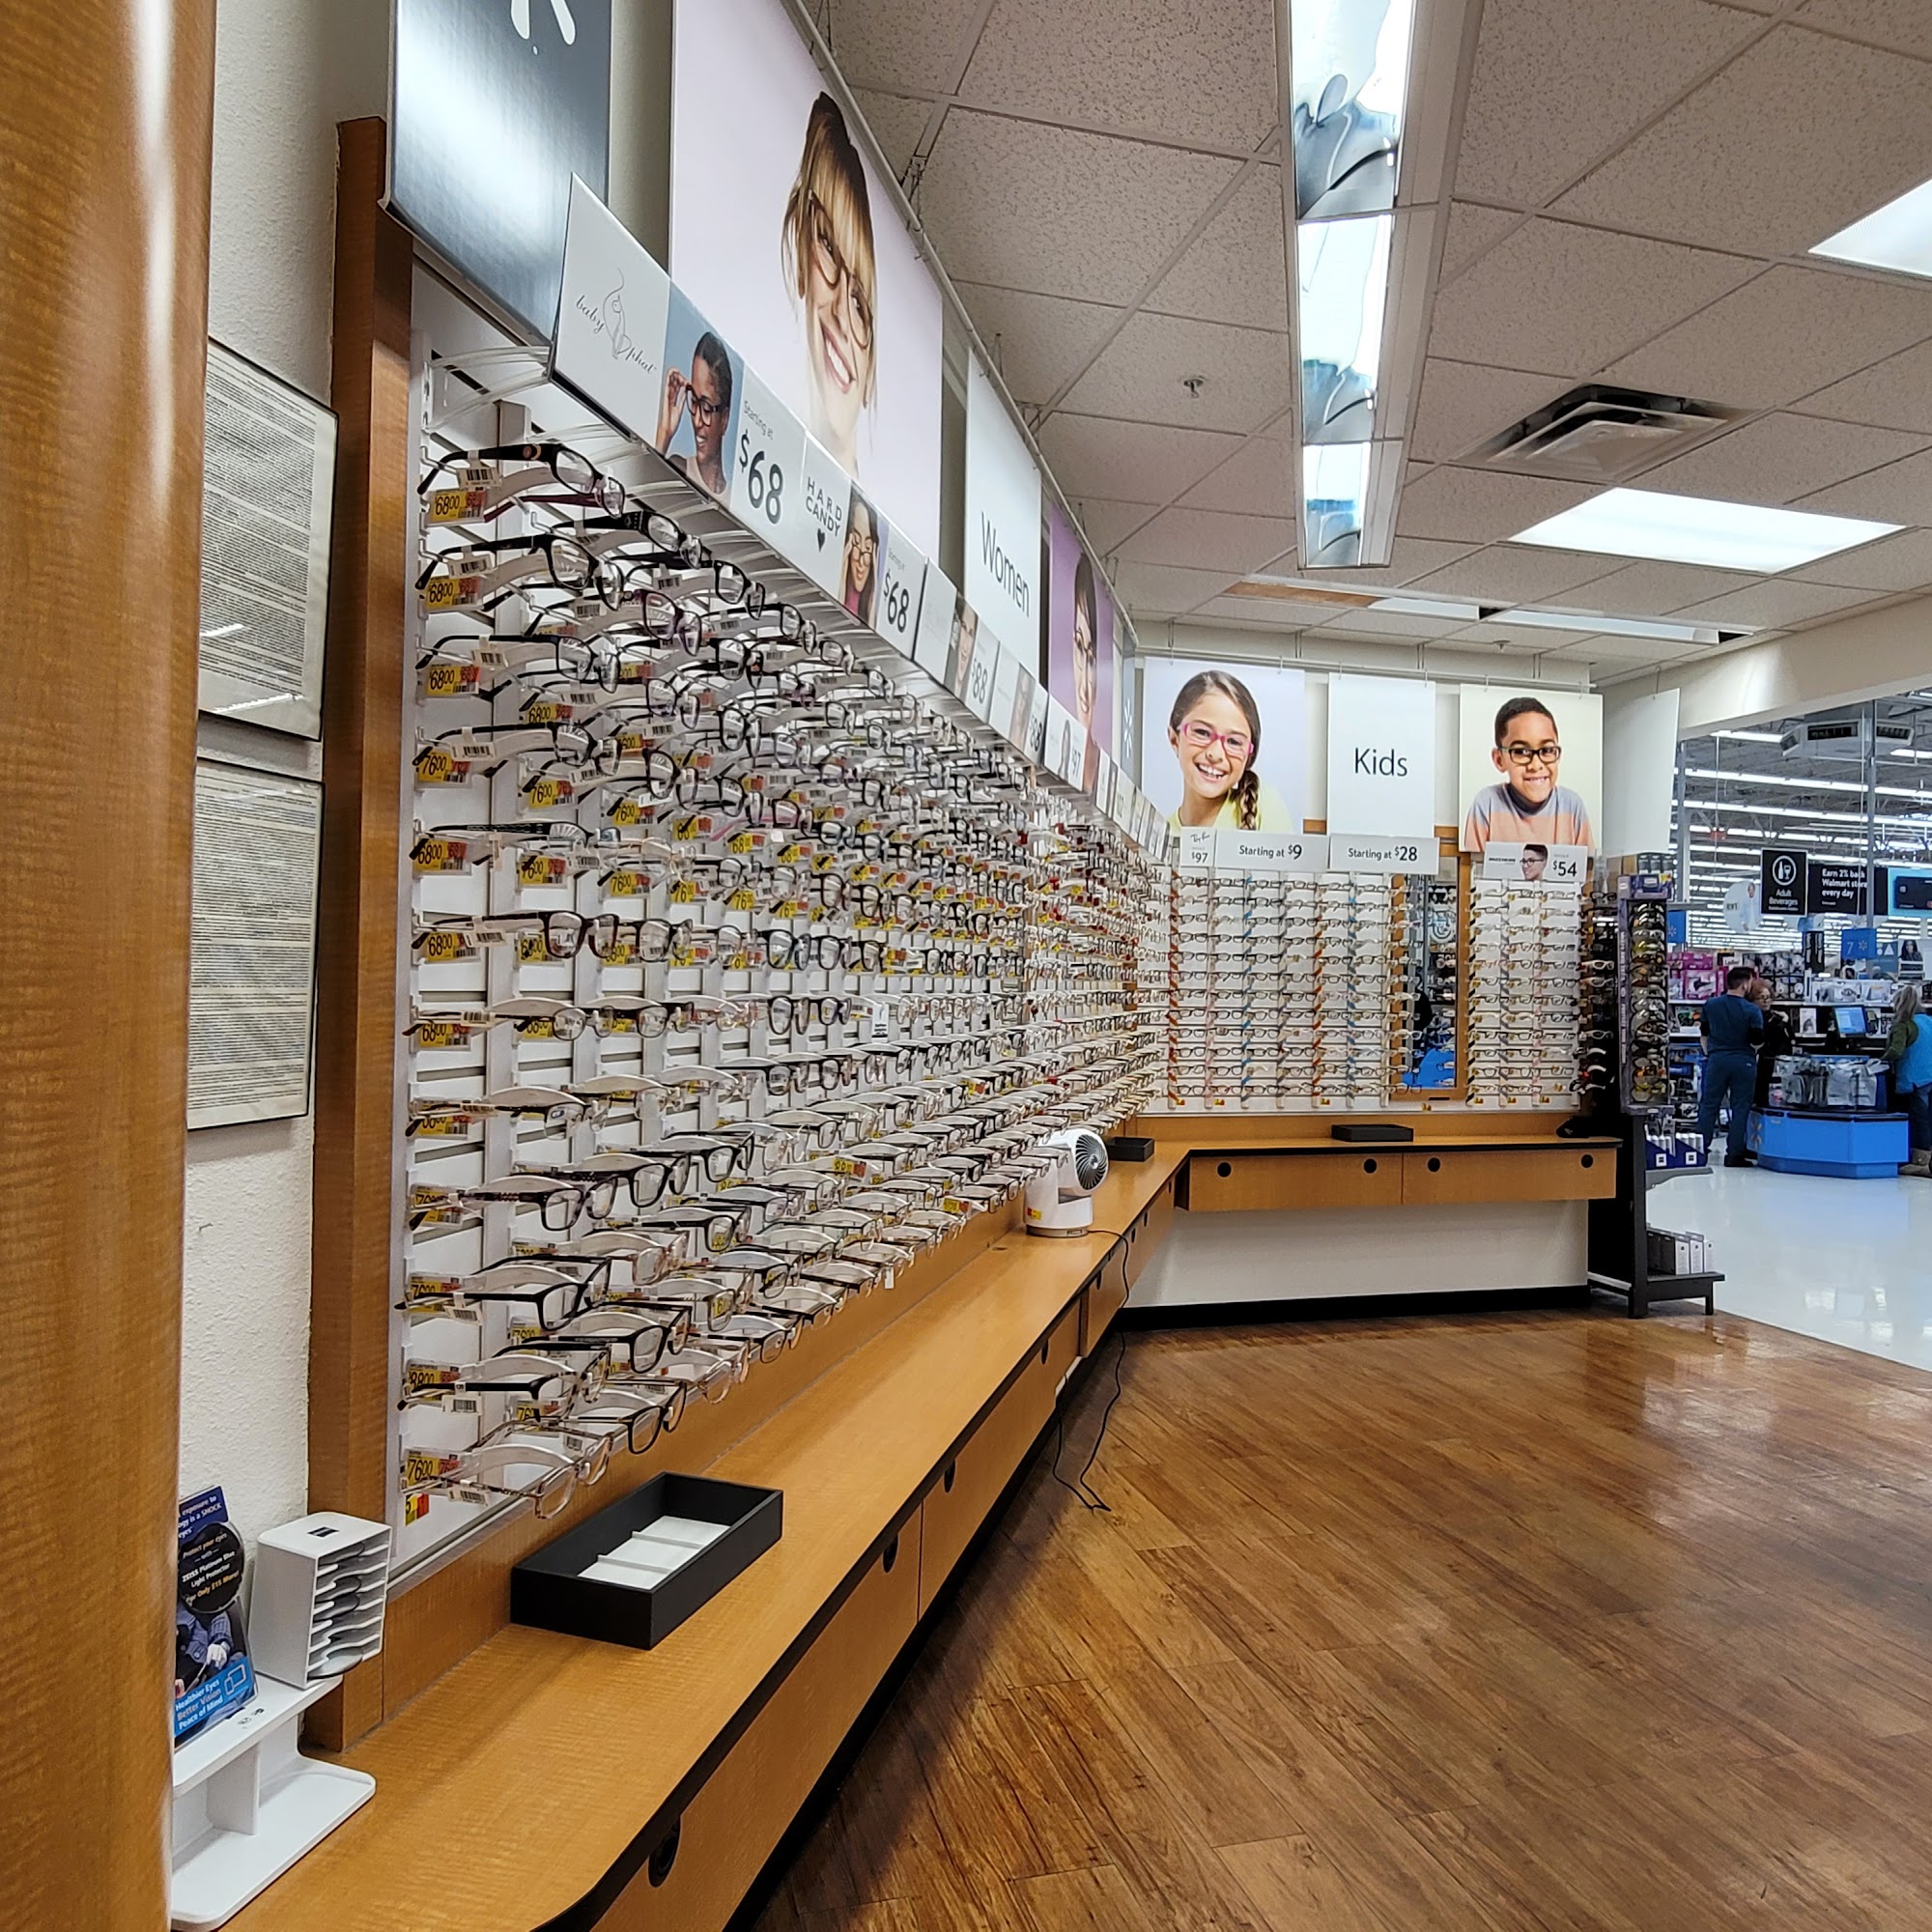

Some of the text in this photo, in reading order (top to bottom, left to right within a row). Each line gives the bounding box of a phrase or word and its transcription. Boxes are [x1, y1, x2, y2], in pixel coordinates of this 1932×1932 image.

[575, 295, 606, 333] baby
[743, 400, 767, 437] Starting
[739, 428, 784, 525] $68
[808, 476, 842, 522] HARD
[806, 496, 840, 537] CANDY
[980, 510, 1030, 618] Women
[883, 568, 910, 633] $68
[1354, 747, 1408, 777] Kids
[1191, 851, 1208, 864] $97
[1238, 844, 1302, 860] Starting at $9
[1348, 847, 1381, 861] Starting
[1394, 846, 1417, 861] $28
[1552, 860, 1577, 877] $54
[1822, 868, 1838, 877] Earn
[1839, 869, 1849, 878] 2%
[1776, 888, 1792, 896] Adult
[1822, 878, 1850, 887] Walmart
[1822, 889, 1854, 899] every day
[1768, 896, 1799, 907] Beverages
[1847, 942, 1854, 954] 7
[182, 1495, 217, 1516] exposure to
[201, 1502, 221, 1518] SHOCK
[183, 1533, 227, 1559] Protect your eyes
[182, 1550, 236, 1582] ZEISS Platinum Blue
[191, 1563, 230, 1588] Light Protector
[197, 1585, 212, 1598] Only
[175, 1679, 220, 1712] Healthier Eyes
[177, 1689, 221, 1720] Better Vision
[179, 1695, 223, 1730] Peace of Mind
